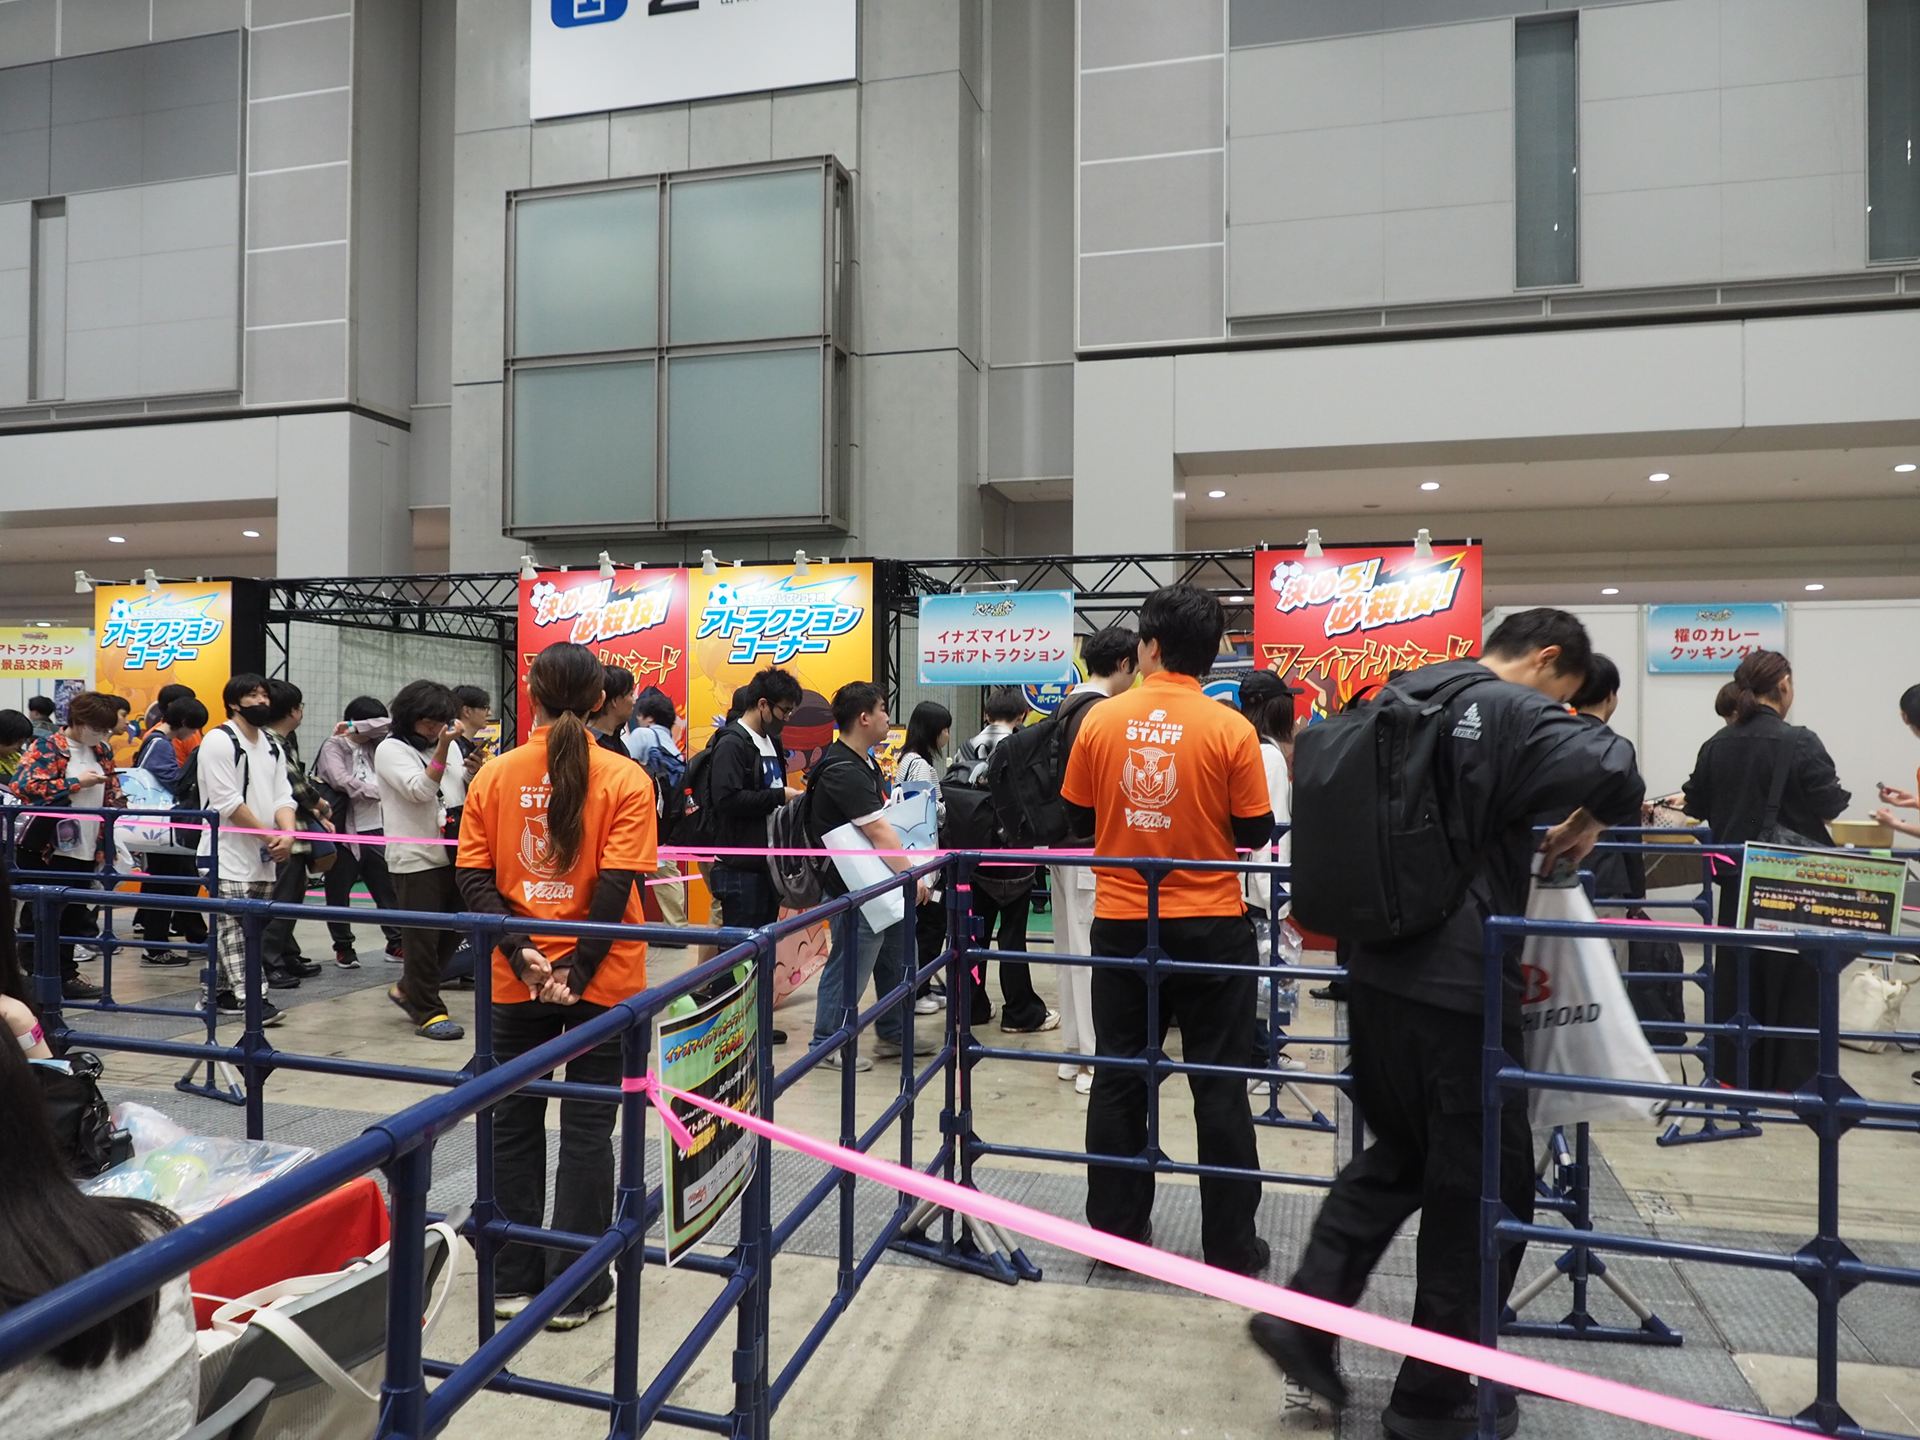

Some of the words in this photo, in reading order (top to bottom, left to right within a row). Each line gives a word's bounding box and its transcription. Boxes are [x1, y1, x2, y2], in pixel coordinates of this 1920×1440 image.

[697, 606, 864, 638] アトラクション
[102, 618, 223, 647] アトラクション
[938, 628, 1051, 644] イナズマイレブン
[1674, 628, 1760, 643] 櫂のカレー
[124, 645, 198, 669] コーナー
[729, 634, 829, 664] コーナー
[924, 649, 1065, 664] コラボアトラクション
[1, 659, 63, 671] 景品交換所
[1037, 695, 1065, 704] ポイント
[1126, 726, 1183, 745] STAFF
